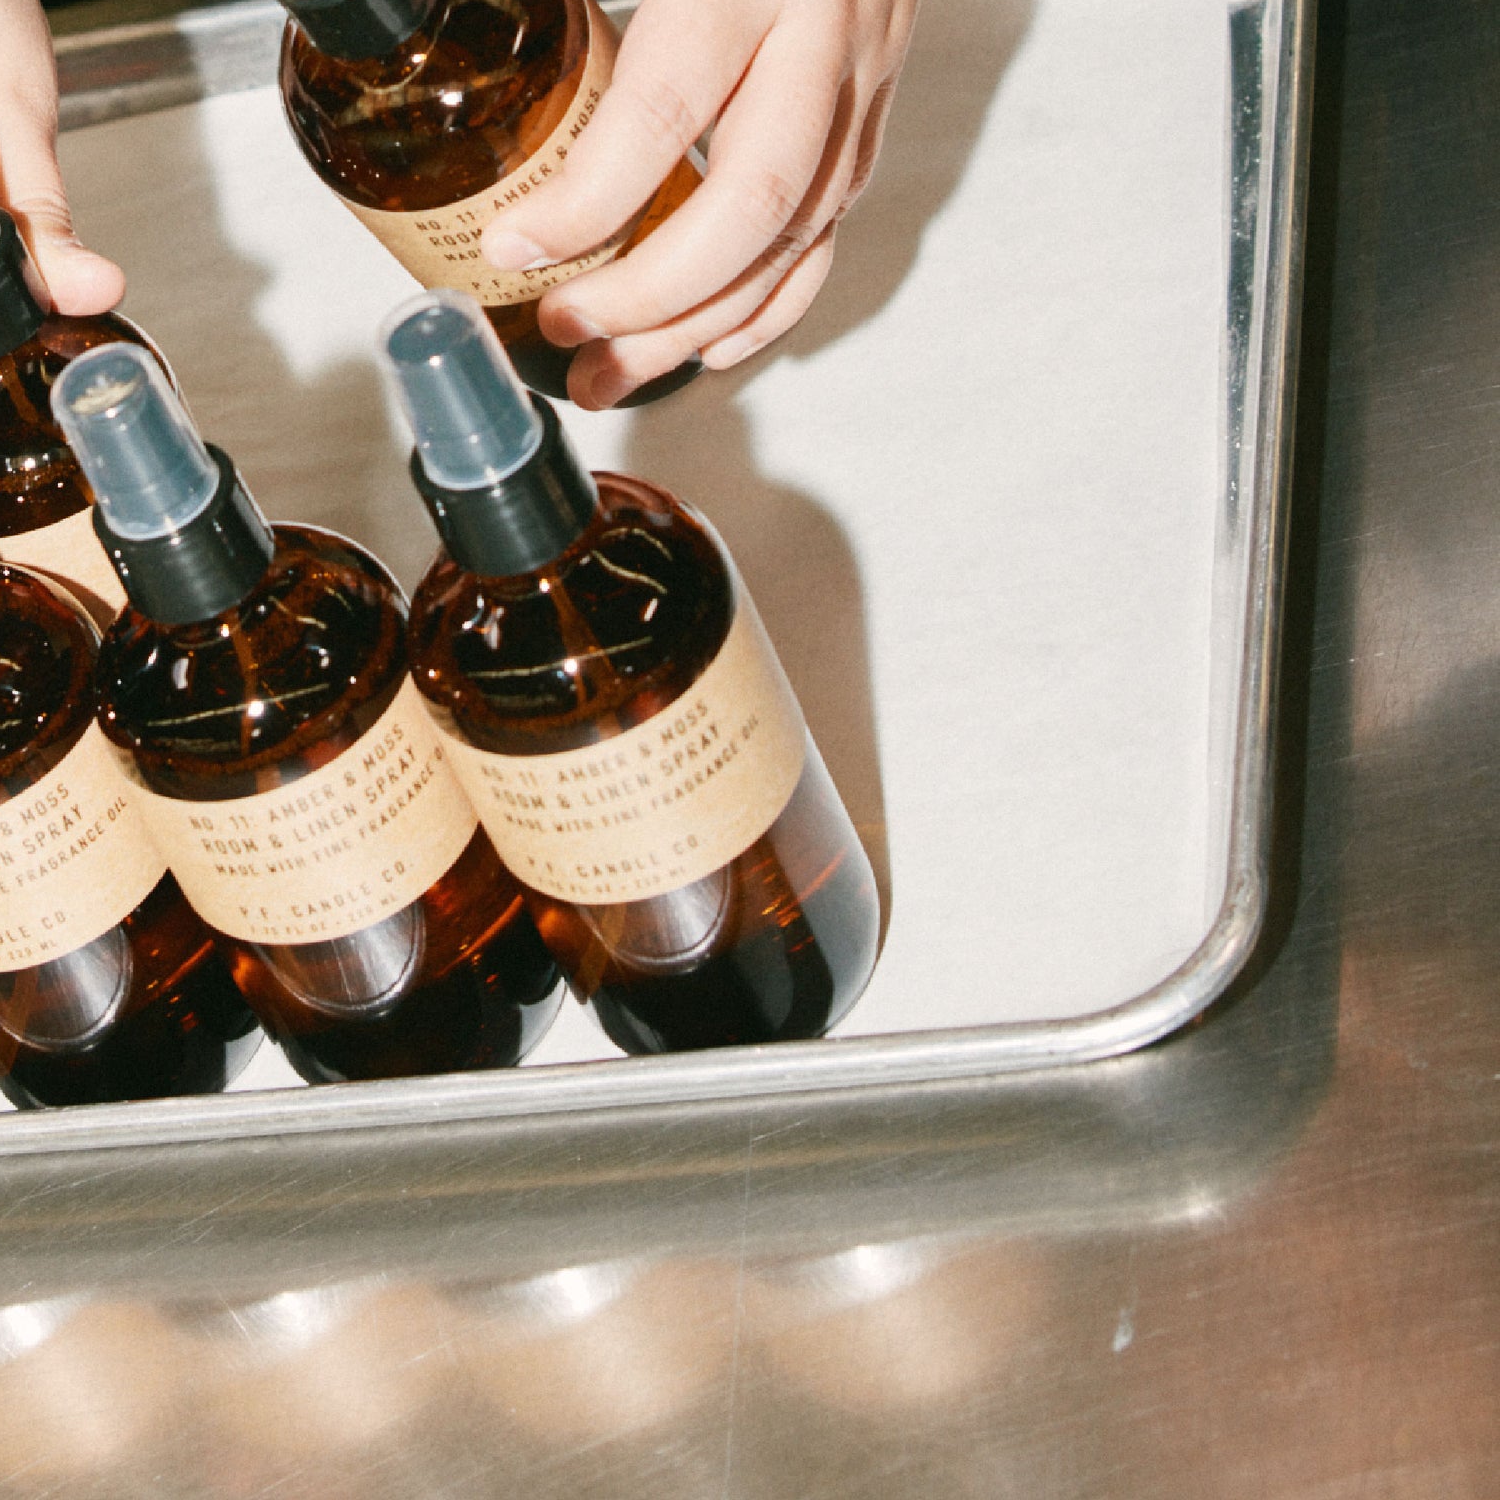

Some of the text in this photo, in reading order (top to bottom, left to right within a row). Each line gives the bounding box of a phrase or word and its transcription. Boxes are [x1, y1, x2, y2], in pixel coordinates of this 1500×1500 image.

[494, 163, 552, 210] AMBER
[557, 145, 568, 160] &
[570, 88, 600, 140] MOSS
[429, 228, 482, 247] ROOM
[444, 248, 482, 262] MAD
[268, 784, 334, 823] AMBER
[344, 771, 357, 788] &
[363, 723, 404, 772] MOSS
[491, 723, 720, 810] ROOM & LINEN SPRAY
[559, 752, 627, 783] AMBER
[638, 742, 652, 758] &
[661, 699, 708, 744] MOSS
[650, 740, 739, 810] FRAGRANCE
[0, 821, 13, 836] &
[19, 783, 70, 826] MOSS
[22, 803, 82, 854] SPRAY
[201, 838, 260, 856] ROOM
[268, 834, 283, 849] &
[293, 803, 357, 842] LINEN
[365, 746, 418, 804] SPRAY
[215, 762, 435, 877] MADE WITH FINE FRAGRANCE
[15, 821, 104, 887] FRAGRANCE
[106, 796, 127, 821] OIL
[576, 853, 657, 878] CANDLE
[291, 880, 371, 918] CANDLE
[382, 860, 415, 883] CO.
